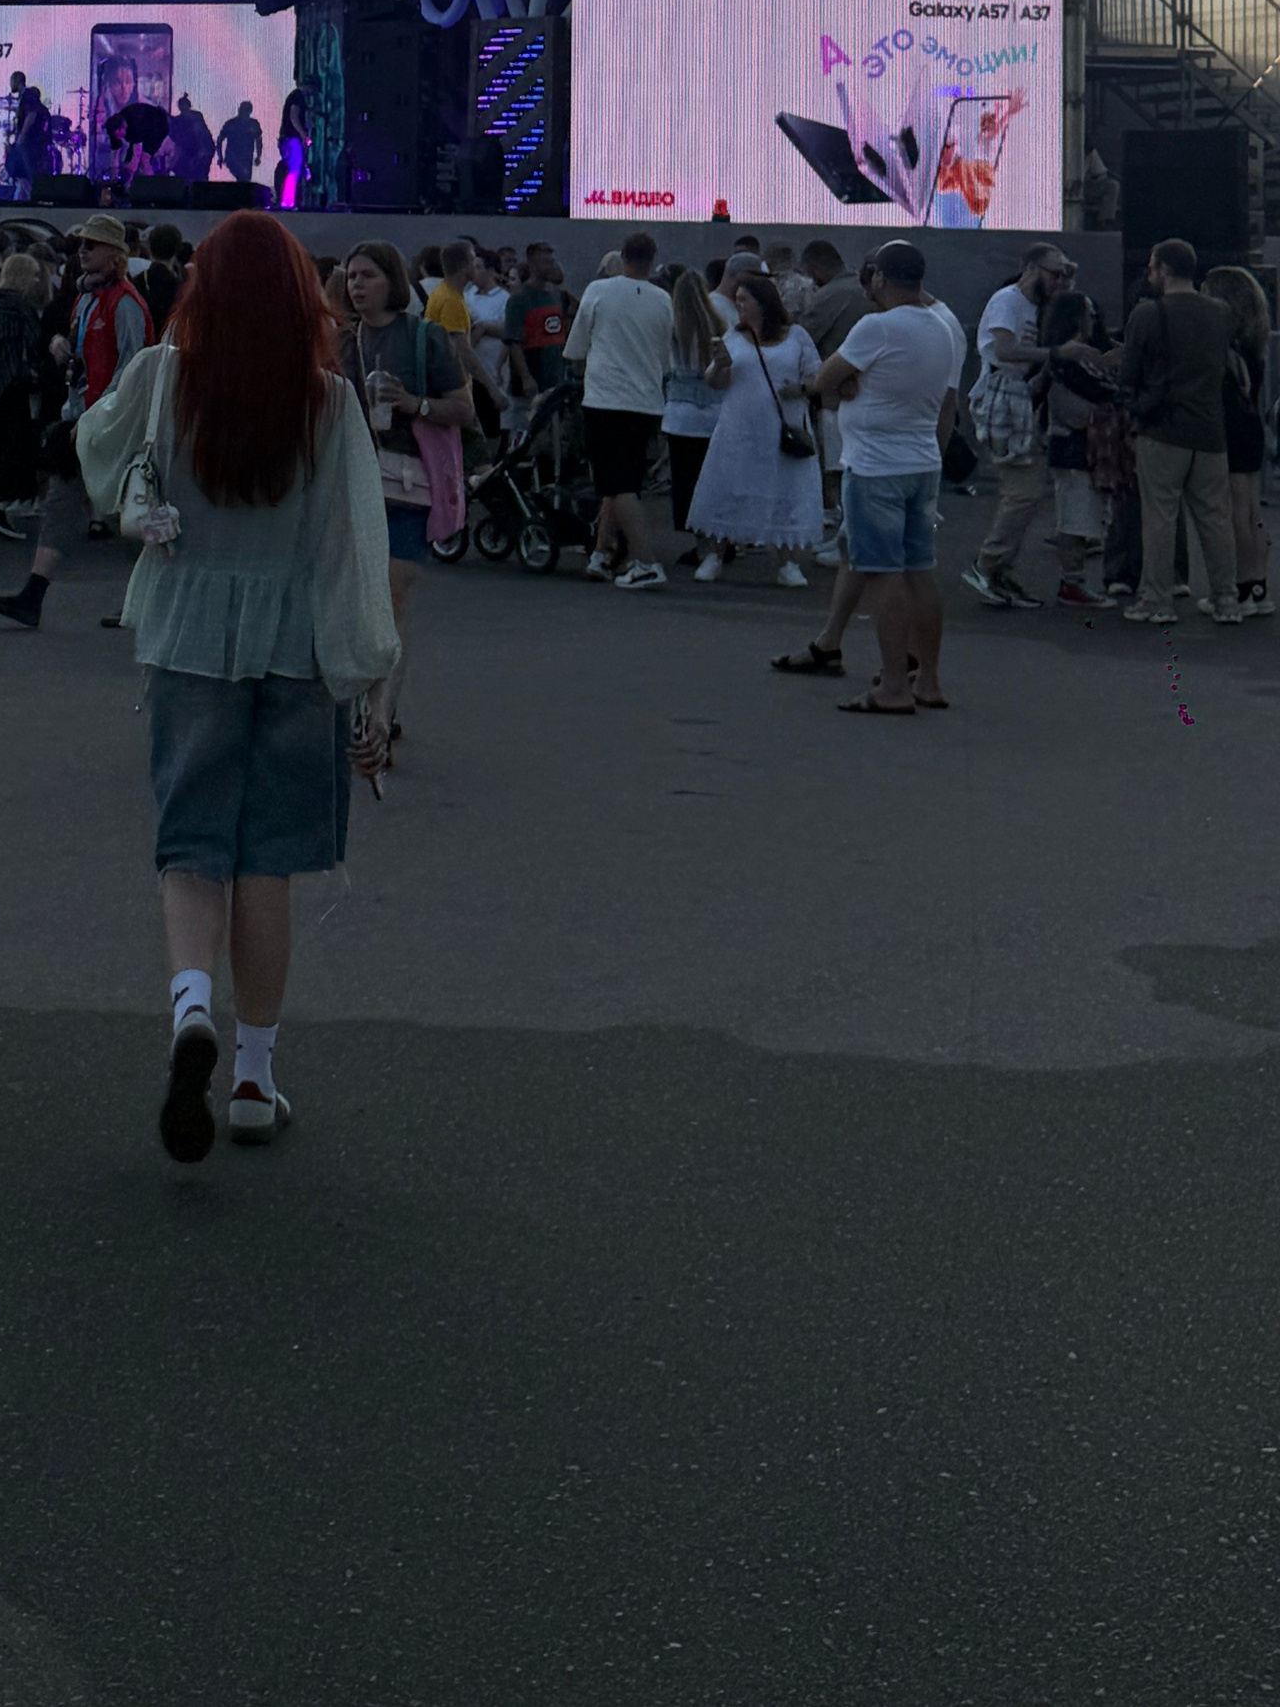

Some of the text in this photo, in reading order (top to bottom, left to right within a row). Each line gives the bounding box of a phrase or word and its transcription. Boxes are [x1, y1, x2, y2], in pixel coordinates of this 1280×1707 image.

[908, 1, 1051, 22] Galaxy A57 A37
[821, 34, 852, 76] А
[862, 29, 914, 79] ЭТО
